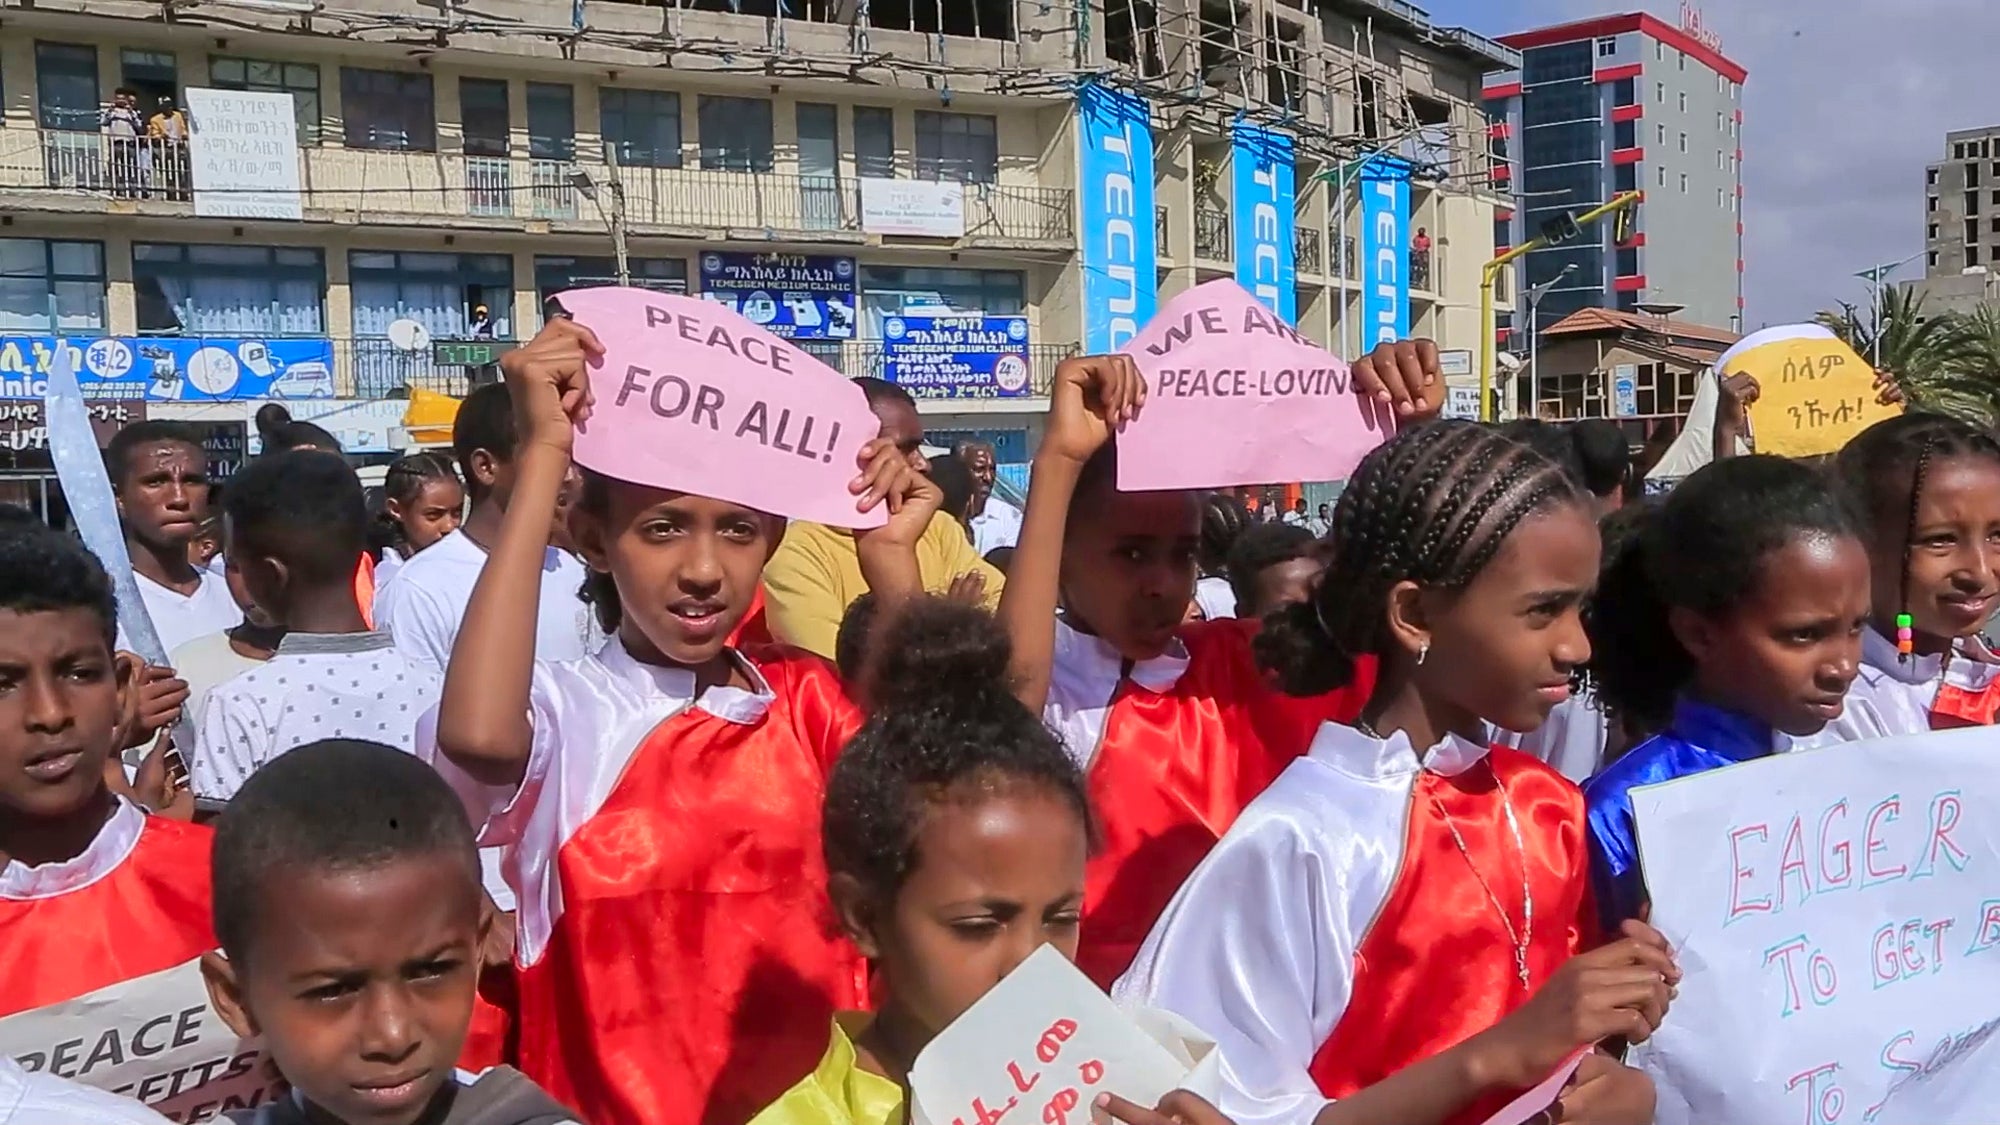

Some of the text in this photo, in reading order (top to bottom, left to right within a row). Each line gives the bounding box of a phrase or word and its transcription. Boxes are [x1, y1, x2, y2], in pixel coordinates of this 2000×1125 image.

[710, 279, 851, 291] TEMESGEN MEDIUM CLINIC
[645, 304, 794, 375] PEACE
[892, 344, 1024, 353] TEMESGEN MEDIUM CLINIC
[1146, 306, 1228, 356] WE
[1157, 368, 1355, 397] PEACE-LOVIN
[1782, 355, 1845, 383] ሰላም
[615, 365, 841, 464] FOR ALL!
[1722, 789, 1970, 929] EAGER
[1761, 934, 1837, 1018] TO
[1873, 918, 1955, 990] GET
[15, 1004, 207, 1078] PEACE
